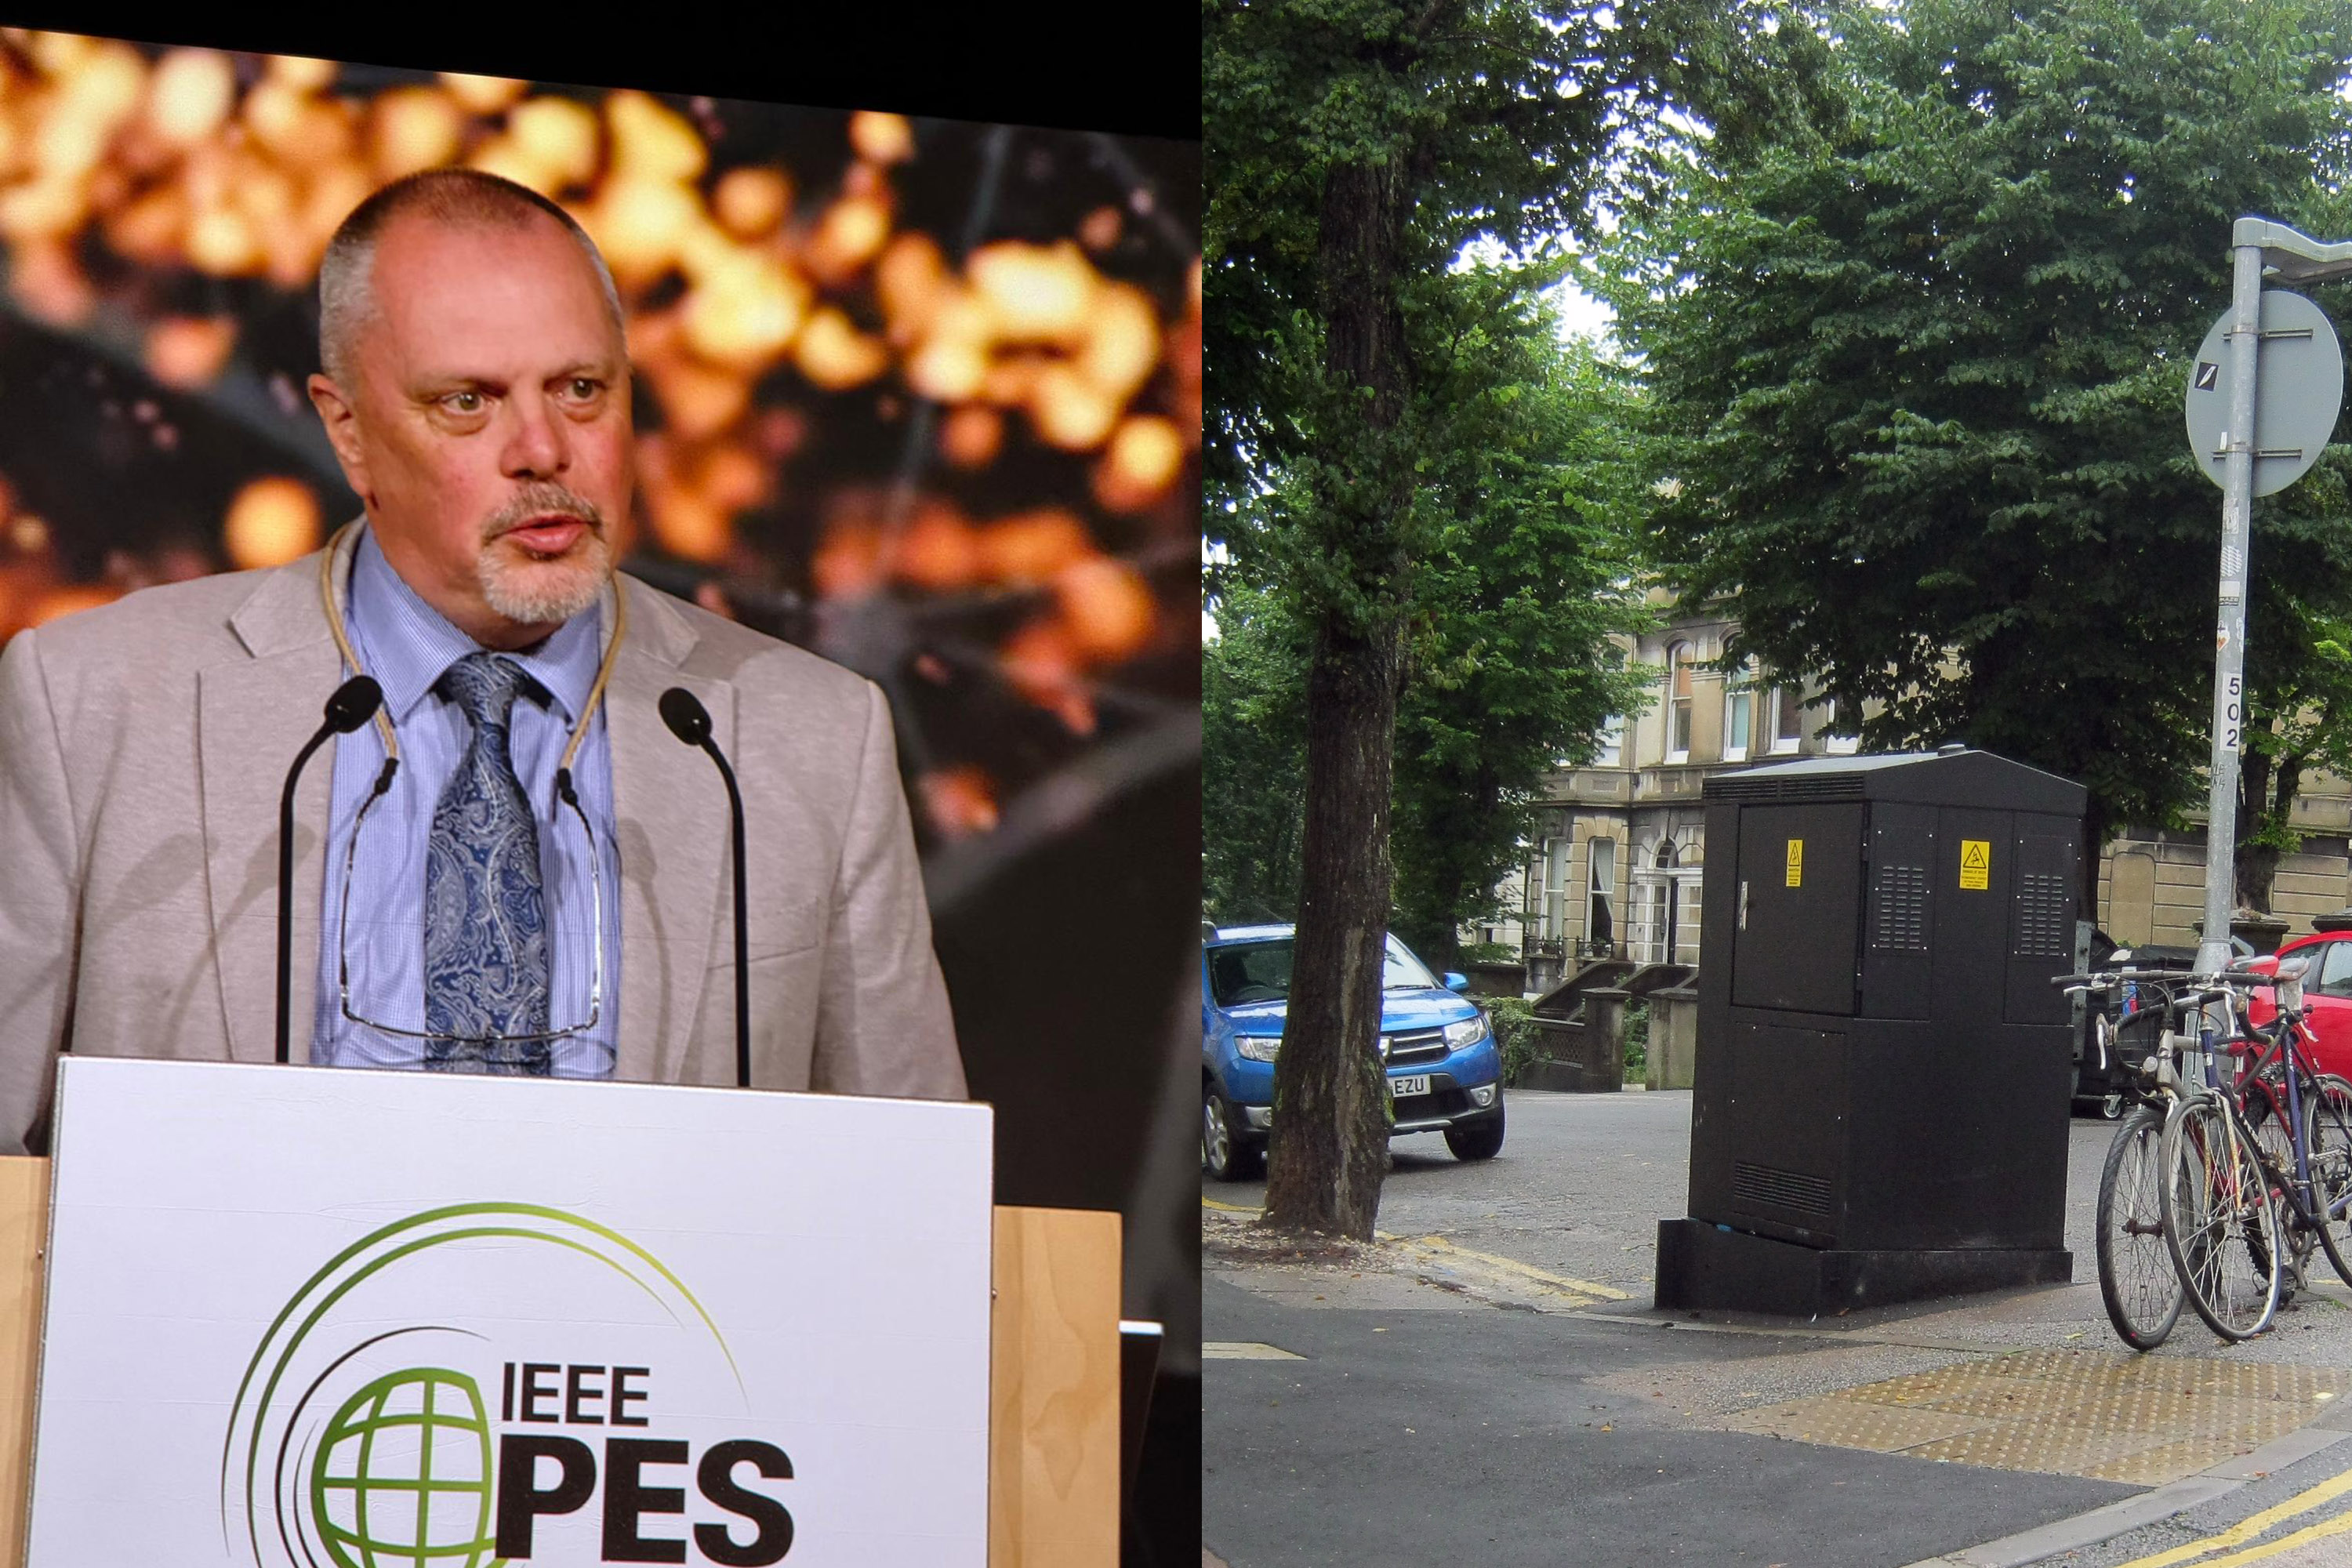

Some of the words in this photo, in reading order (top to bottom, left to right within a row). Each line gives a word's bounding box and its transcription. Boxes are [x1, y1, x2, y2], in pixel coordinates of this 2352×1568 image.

[2227, 677, 2240, 747] 502
[1394, 1077, 1425, 1095] EZU
[503, 1362, 650, 1427] IEEE
[495, 1434, 794, 1568] PES
